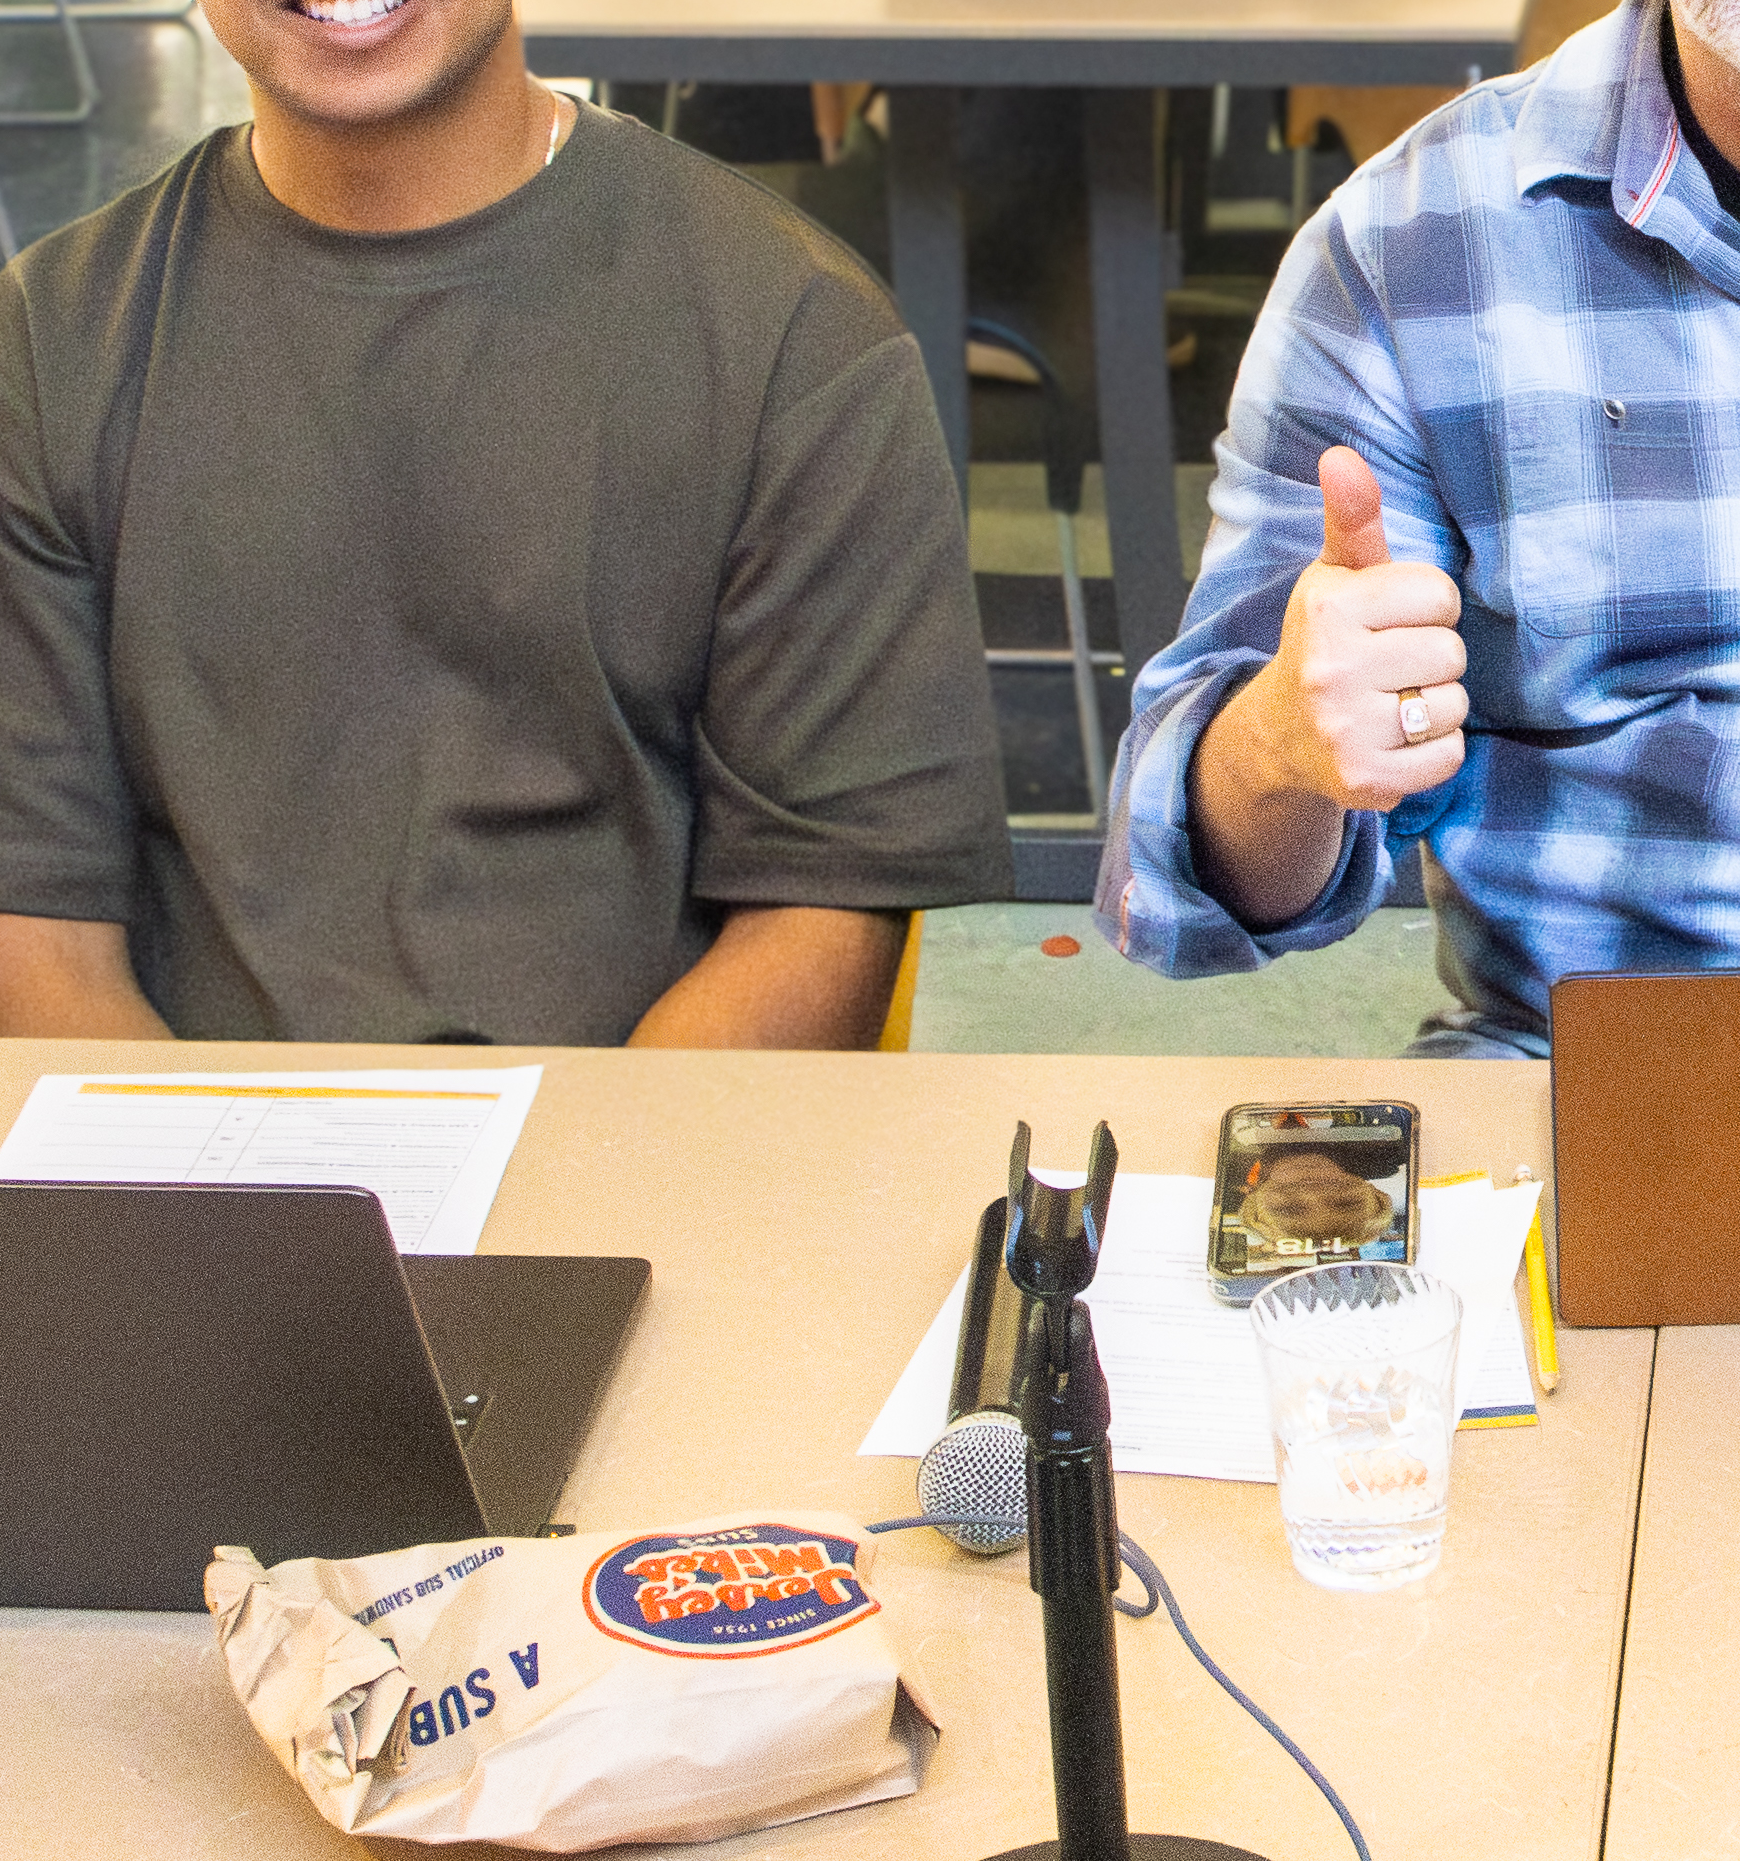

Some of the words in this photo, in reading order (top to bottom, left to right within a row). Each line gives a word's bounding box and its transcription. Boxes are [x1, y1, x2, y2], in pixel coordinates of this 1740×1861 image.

[414, 1573, 444, 1597] SUB
[446, 1546, 505, 1580] OFFICIAL
[636, 1567, 854, 1624] Jersey
[509, 1642, 539, 1690] A
[410, 1668, 496, 1747] SUB
